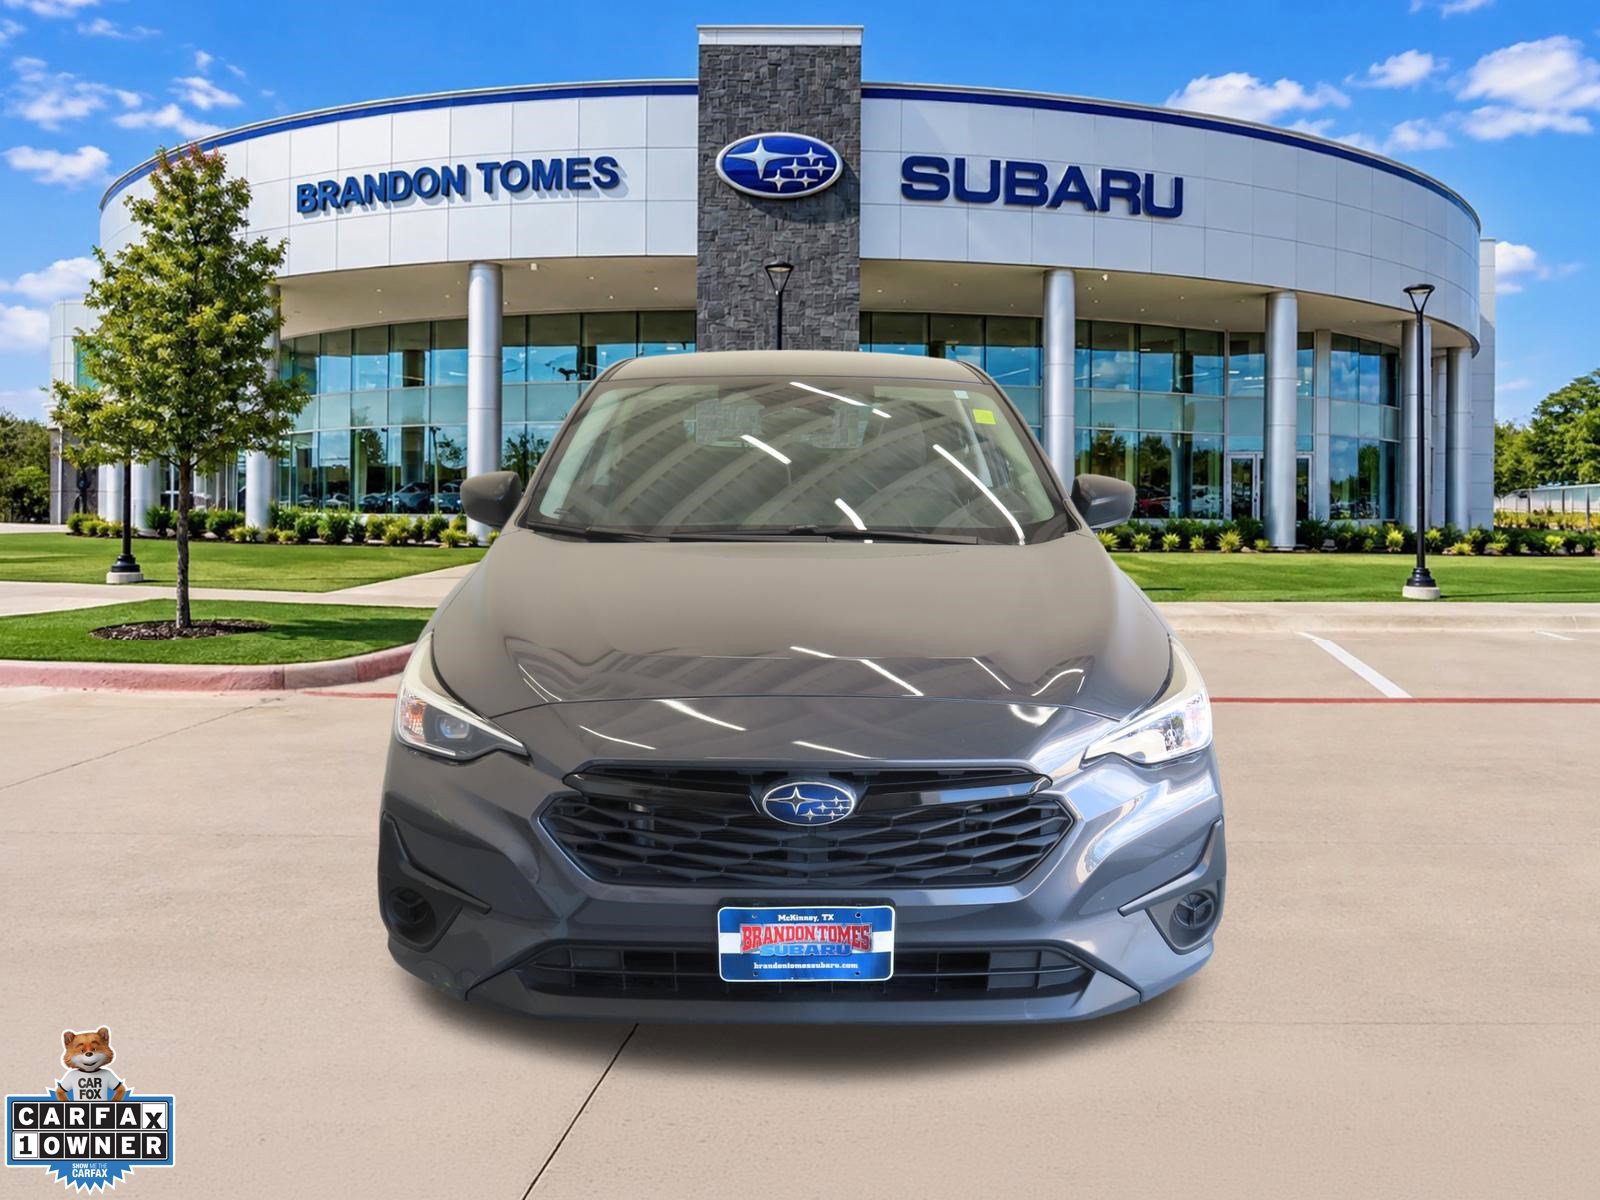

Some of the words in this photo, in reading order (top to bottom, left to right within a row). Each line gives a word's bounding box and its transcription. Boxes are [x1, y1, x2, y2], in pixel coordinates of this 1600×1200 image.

[296, 164, 466, 213] BRANDON
[476, 156, 620, 194] TOMES
[901, 155, 1184, 218] SUBARU
[778, 914, 820, 922] McKinney,
[742, 924, 816, 951] BRANDON
[817, 924, 871, 952] TOMES
[760, 944, 852, 956] SUBARU
